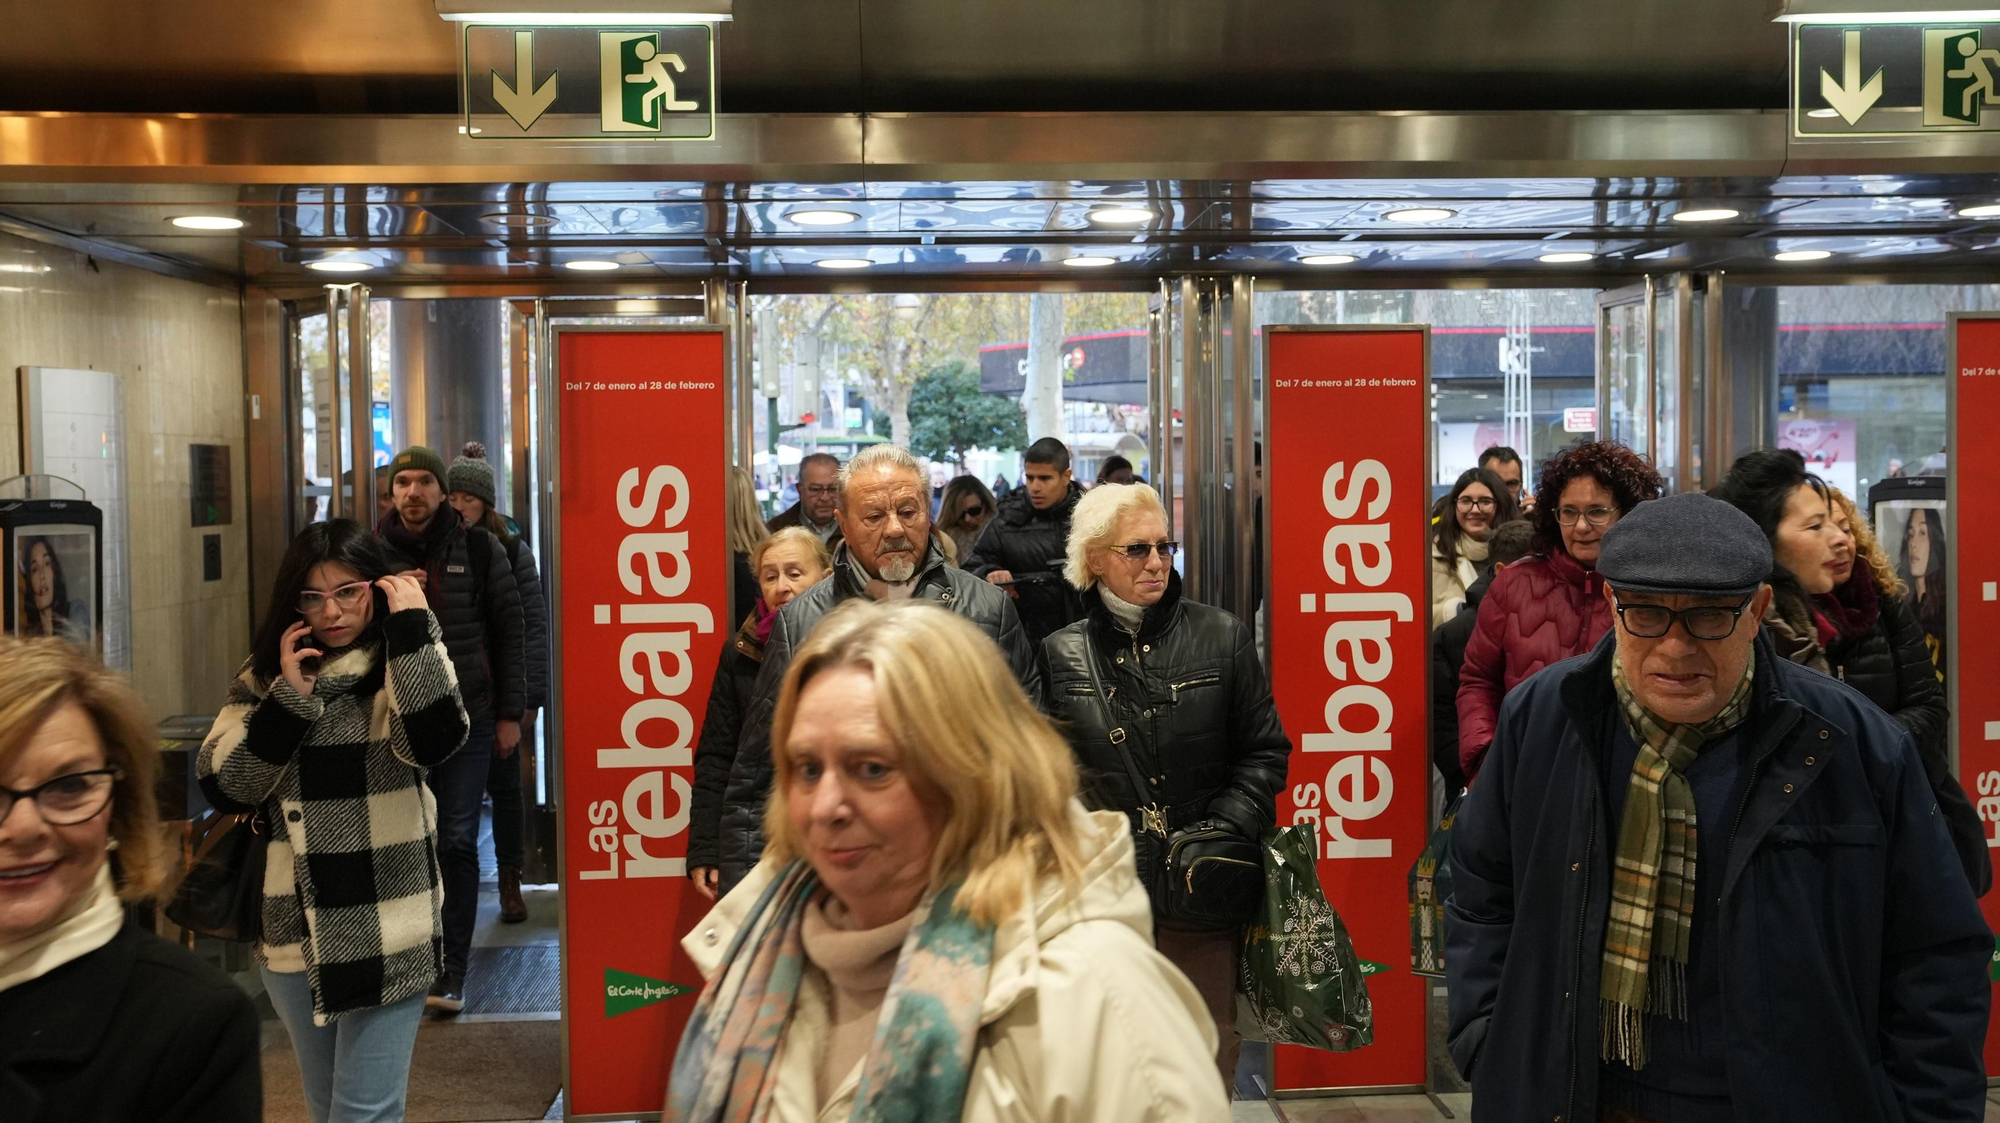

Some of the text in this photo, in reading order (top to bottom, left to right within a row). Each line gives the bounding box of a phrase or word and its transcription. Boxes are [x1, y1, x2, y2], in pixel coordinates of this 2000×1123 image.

[1962, 368, 1976, 376] Del
[1978, 368, 1984, 376] 7
[1985, 367, 1996, 376] de
[566, 380, 715, 391] Del 7 de enero al 28 de febrero
[1275, 377, 1417, 388] Del 7 de enero al 28 de febrero
[1300, 458, 1414, 860] rebajas
[594, 464, 715, 879] rebajas
[579, 799, 619, 881] Las
[607, 982, 679, 1000] El Corte Inglés
